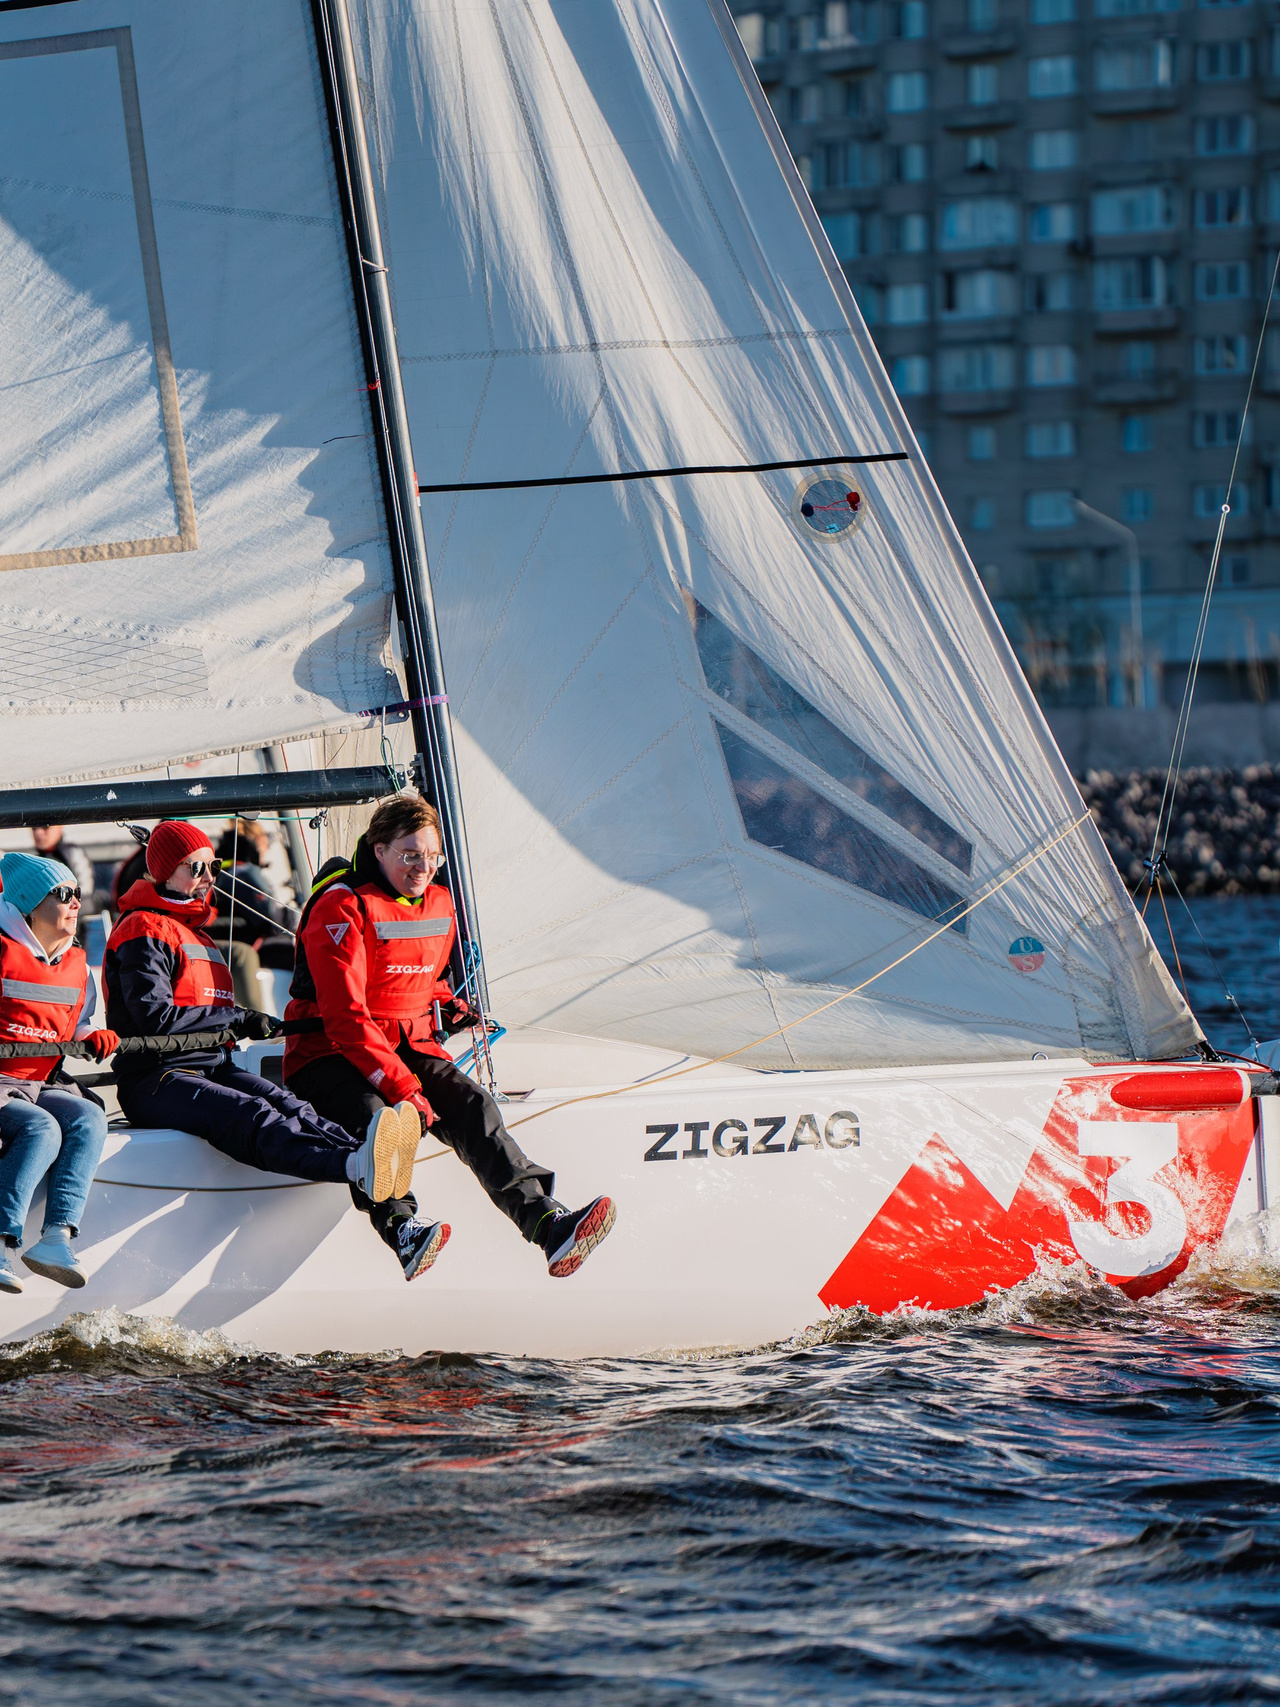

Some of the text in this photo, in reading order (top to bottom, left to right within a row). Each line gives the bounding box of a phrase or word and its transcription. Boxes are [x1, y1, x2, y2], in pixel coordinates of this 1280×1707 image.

[385, 964, 435, 974] ZIGZAG
[6, 1023, 58, 1039] ZIGZAG
[643, 1110, 861, 1162] ZIGZAG
[1068, 1120, 1188, 1277] 3
